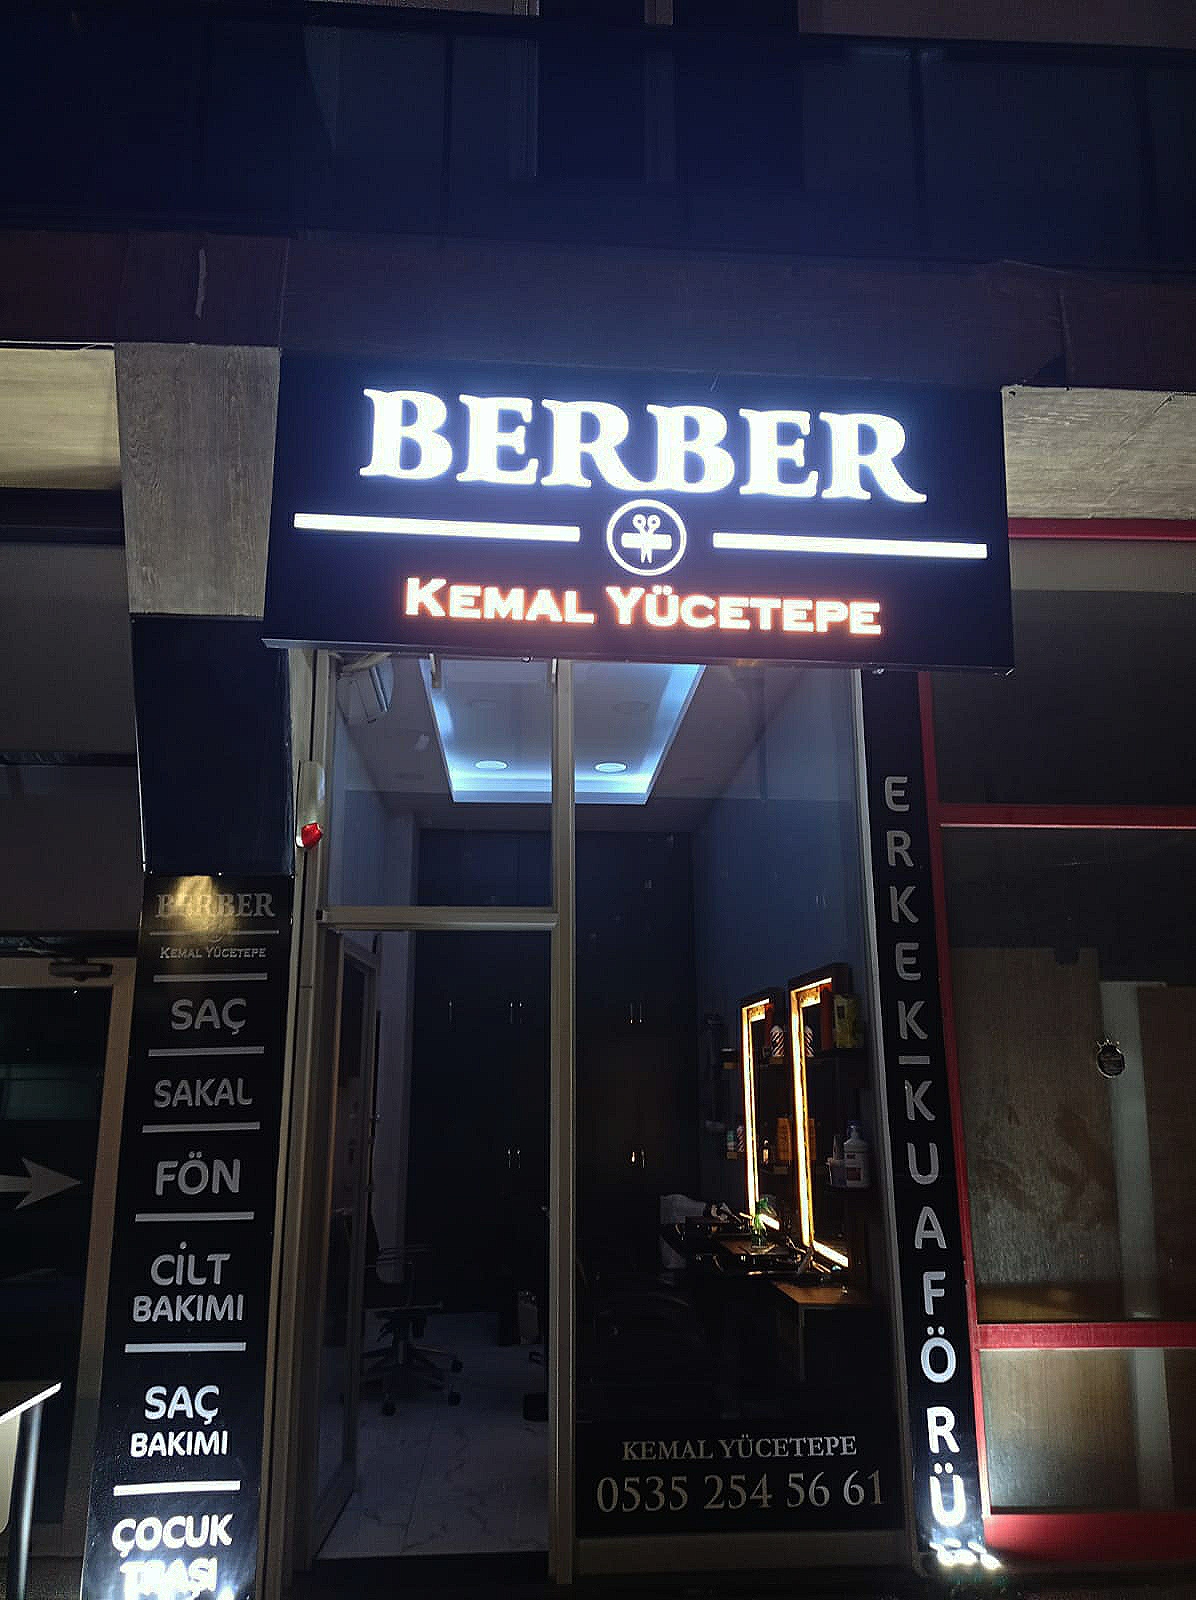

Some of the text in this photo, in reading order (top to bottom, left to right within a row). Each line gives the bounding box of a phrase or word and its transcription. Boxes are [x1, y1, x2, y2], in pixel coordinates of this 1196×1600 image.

[359, 388, 928, 502] BERBER
[405, 577, 883, 636] KEMAL YÜCETEPE
[155, 893, 276, 919] BERBER
[159, 946, 202, 958] KEMAL
[171, 998, 247, 1034] SAÇ
[154, 1078, 252, 1108] SAKAL
[155, 1151, 241, 1195] FÖN
[150, 1241, 231, 1285] CİLT
[132, 1294, 244, 1322] BAKIMI
[144, 1385, 219, 1425] SAÇ
[130, 1431, 228, 1457] BAKIMI
[621, 1433, 857, 1460] KEMAL YÜCETEPE
[597, 1469, 882, 1512] 0535 254 56 61
[112, 1514, 233, 1558] ÇOCUK
